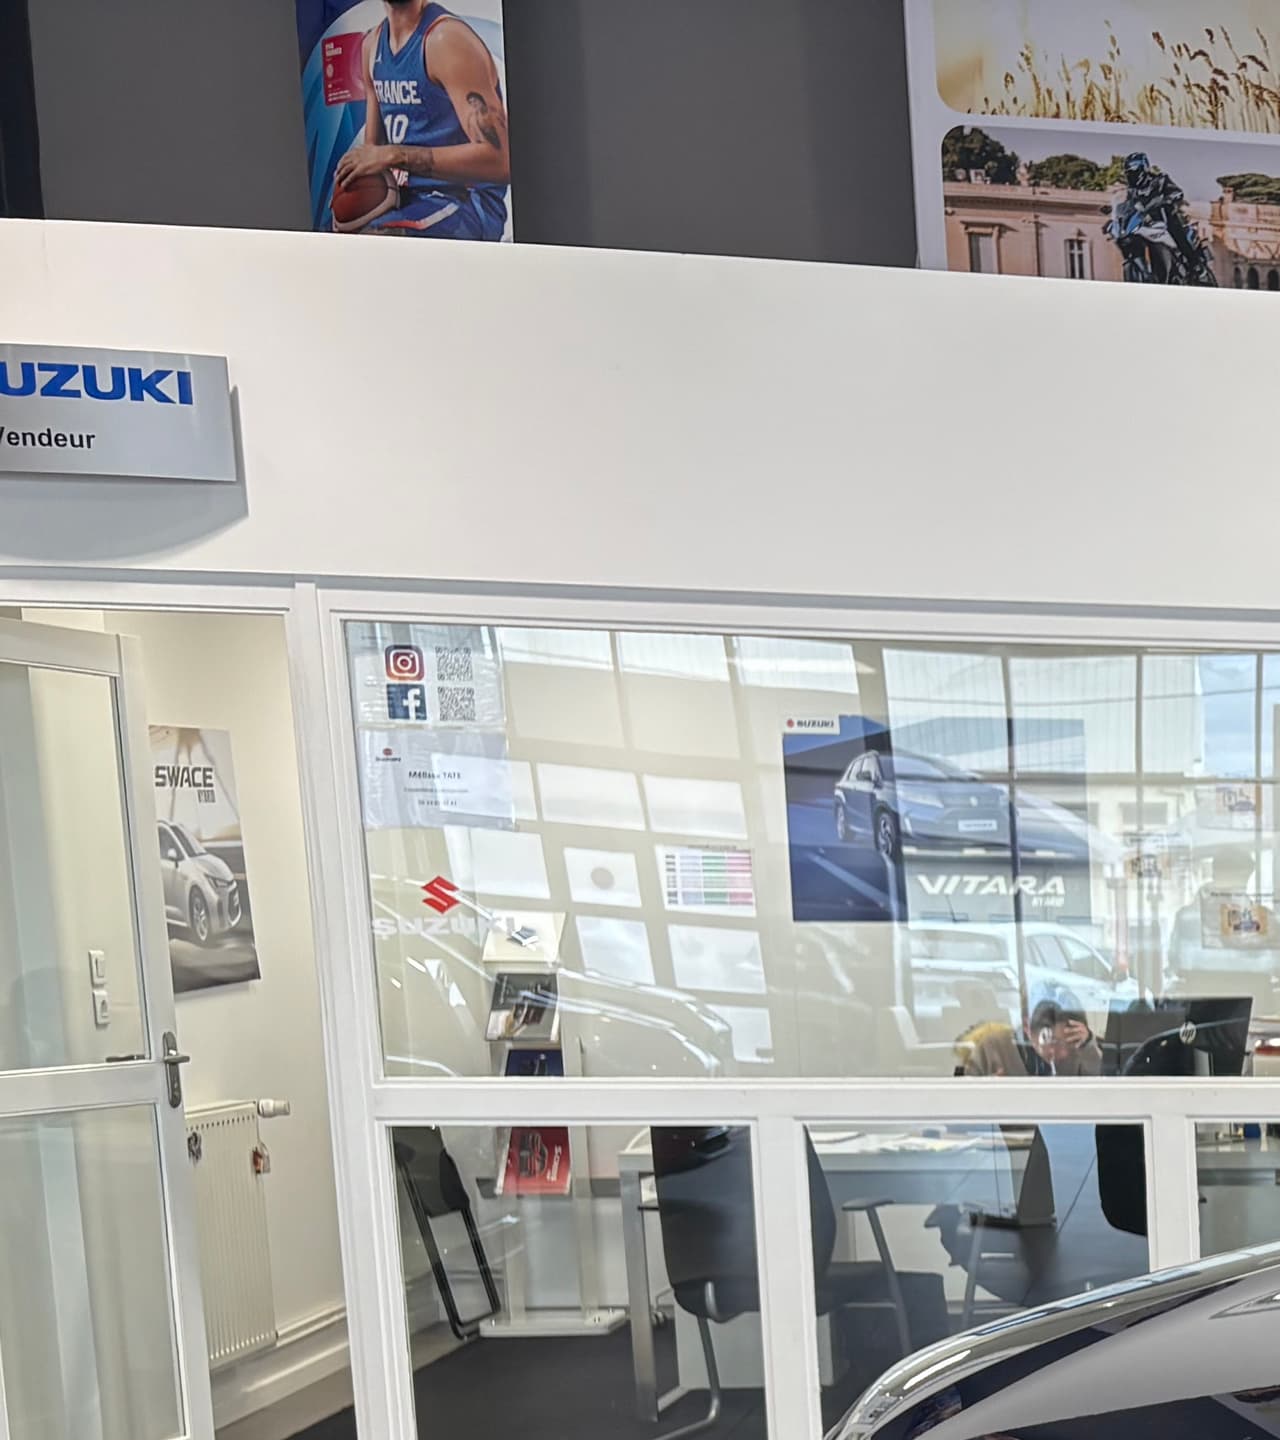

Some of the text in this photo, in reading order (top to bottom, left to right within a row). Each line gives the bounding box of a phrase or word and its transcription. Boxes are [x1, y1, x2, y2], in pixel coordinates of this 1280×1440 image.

[373, 79, 422, 105] FRANCE
[384, 114, 409, 144] 10
[154, 765, 214, 788] SWACE
[916, 874, 1066, 896] VITARA
